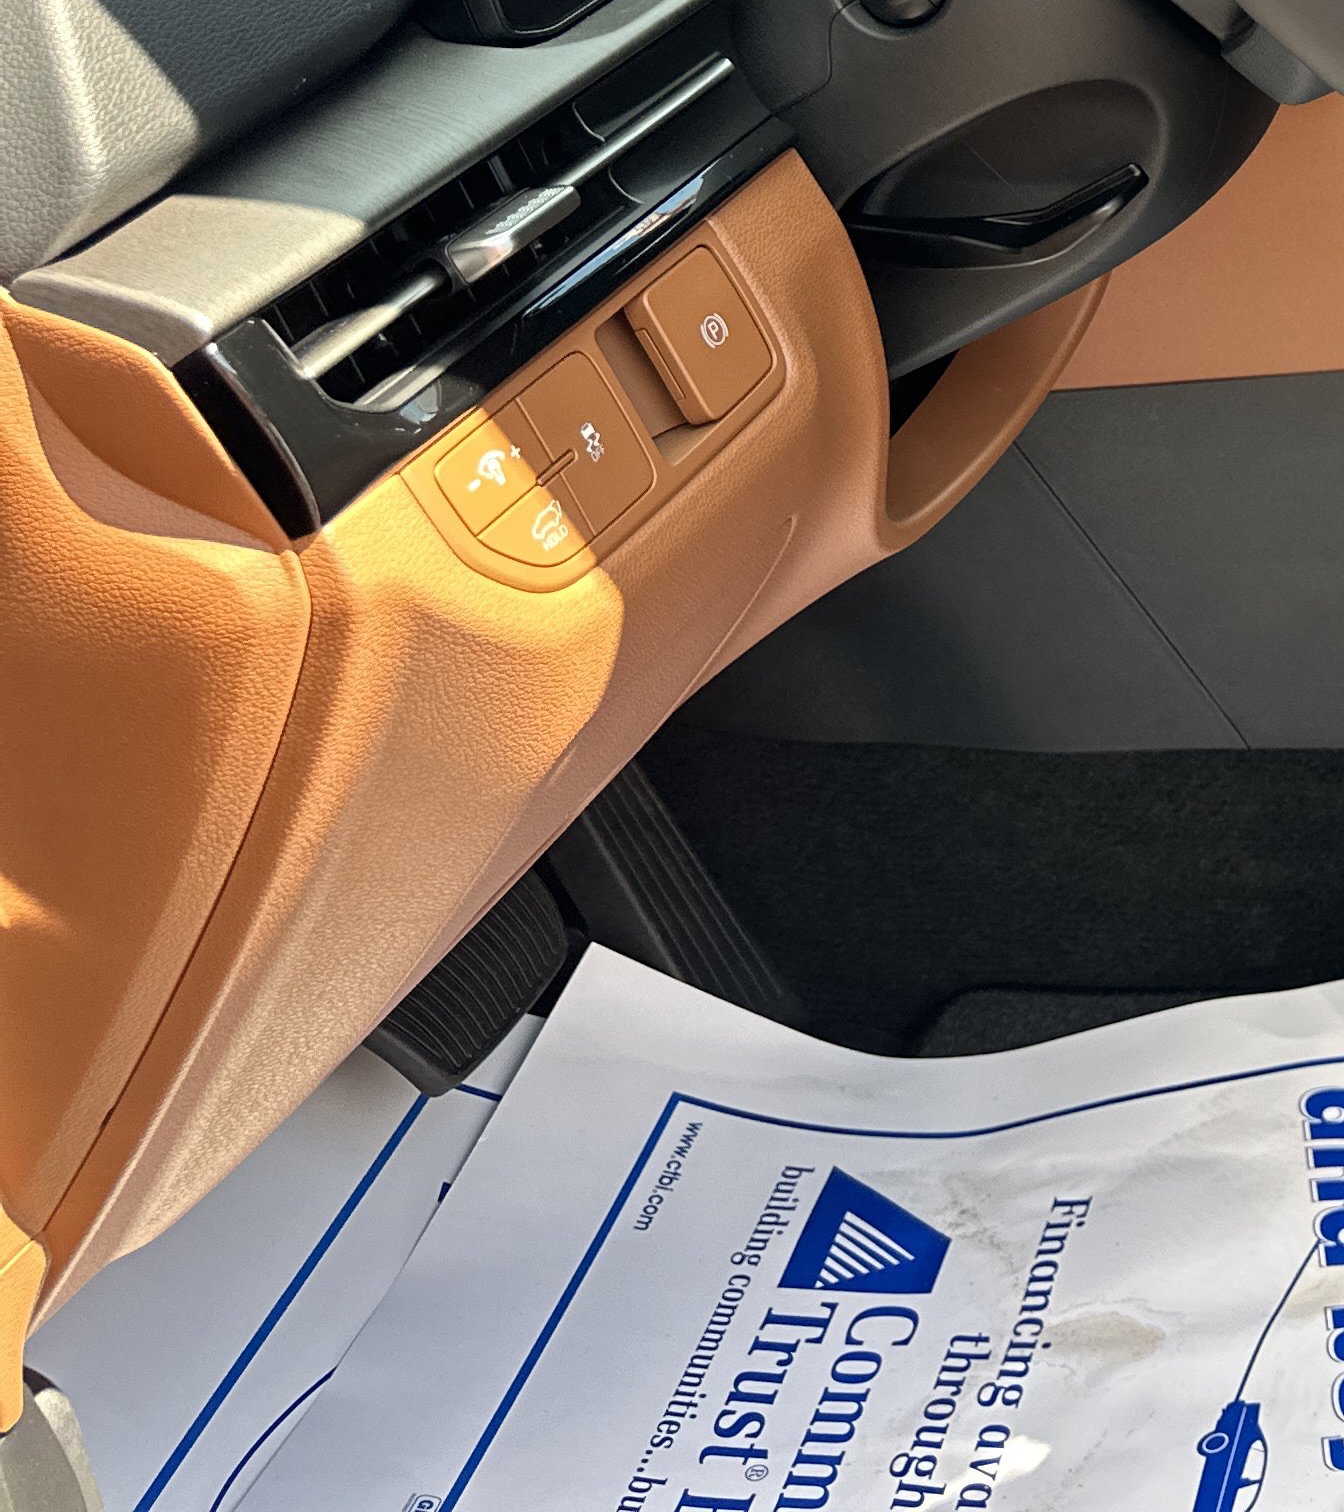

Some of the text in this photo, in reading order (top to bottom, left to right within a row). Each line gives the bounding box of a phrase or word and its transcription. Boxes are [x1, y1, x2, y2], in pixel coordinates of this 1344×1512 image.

[542, 524, 569, 551] HOLD
[633, 1121, 704, 1232] www.ctbi.com
[729, 1164, 816, 1268] building
[976, 1196, 1092, 1410] Financing
[888, 1331, 992, 1511] through
